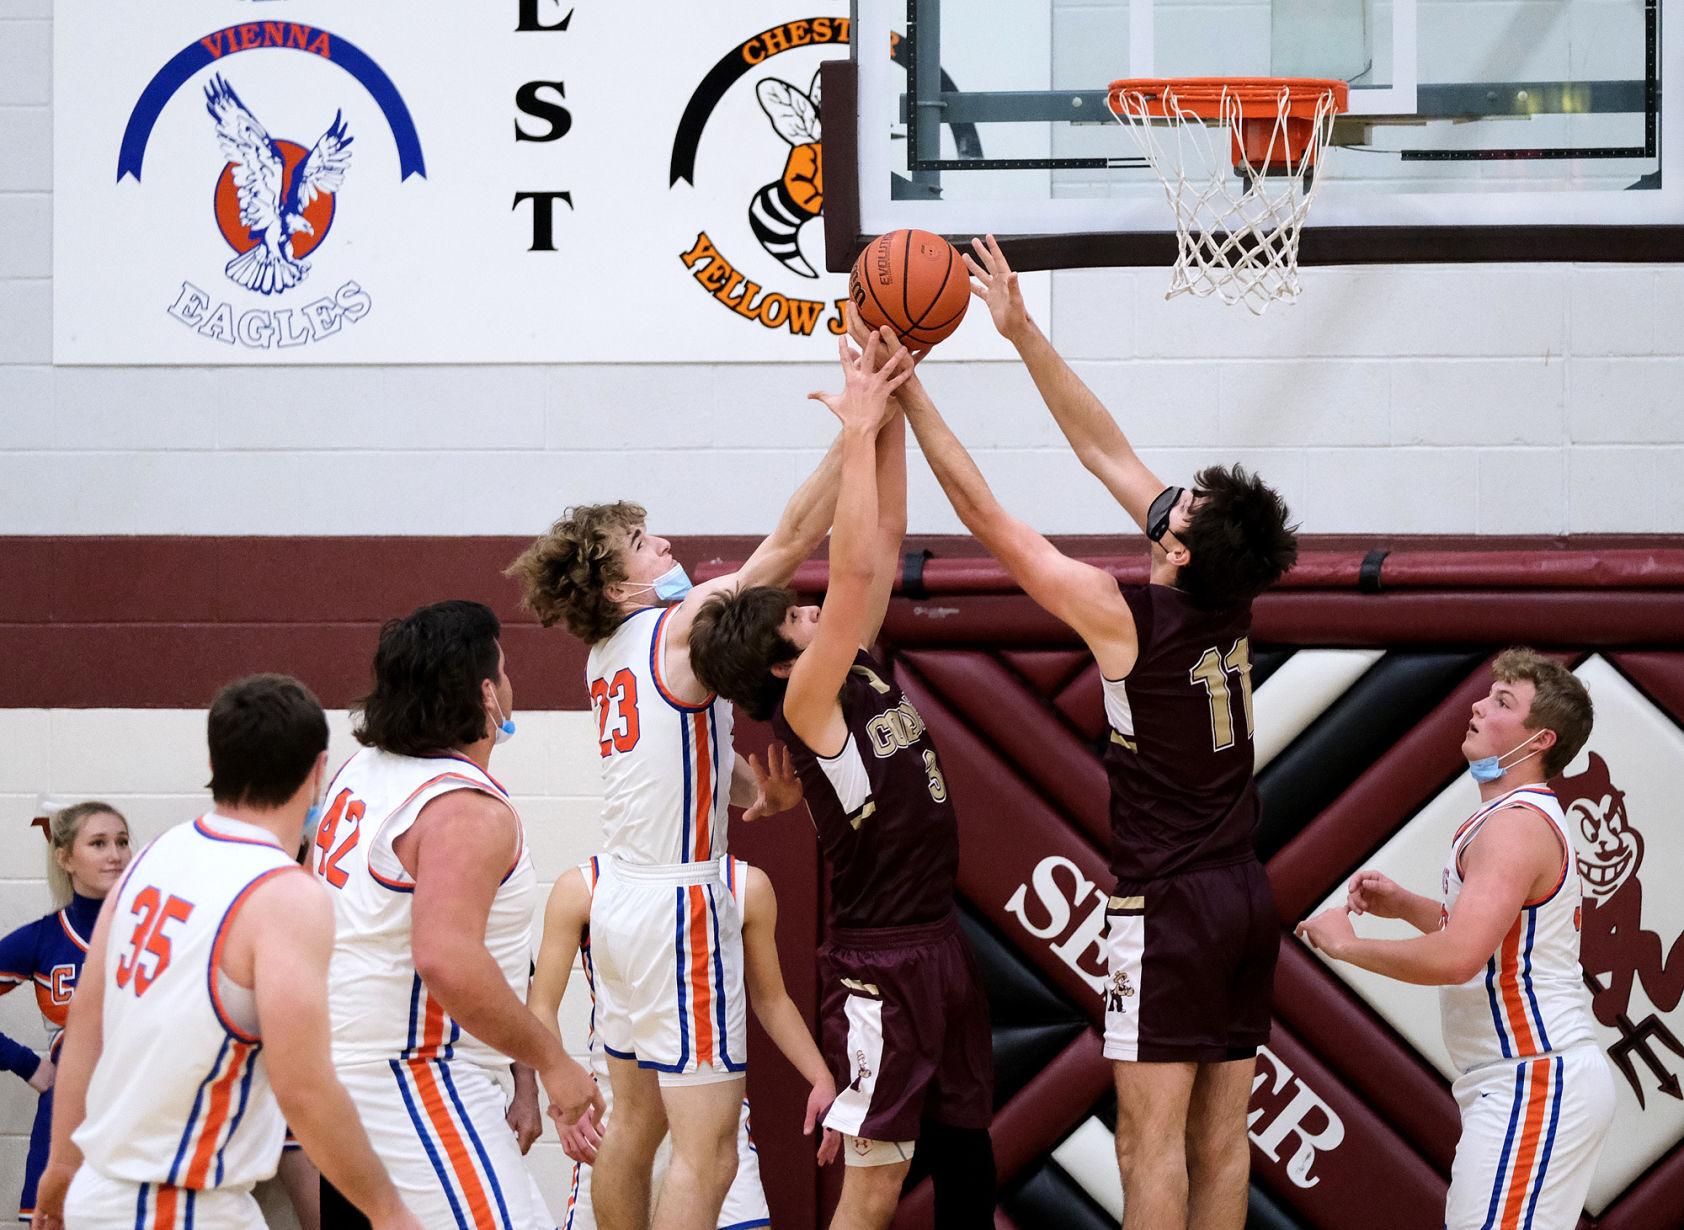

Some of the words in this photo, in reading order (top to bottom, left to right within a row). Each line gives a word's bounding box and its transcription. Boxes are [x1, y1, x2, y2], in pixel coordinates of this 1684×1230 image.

[202, 20, 331, 59] VIENNA
[742, 17, 897, 65] CHEST
[679, 230, 826, 337] YELLOW
[877, 233, 892, 286] EVOLUTI
[167, 279, 373, 350] EAGLES
[591, 667, 641, 758] 23
[1188, 635, 1255, 753] 11
[922, 748, 948, 803] 3
[315, 786, 367, 890] 42
[114, 885, 195, 998] 35
[50, 963, 76, 1007] C
[1004, 855, 1345, 1189] SEER
